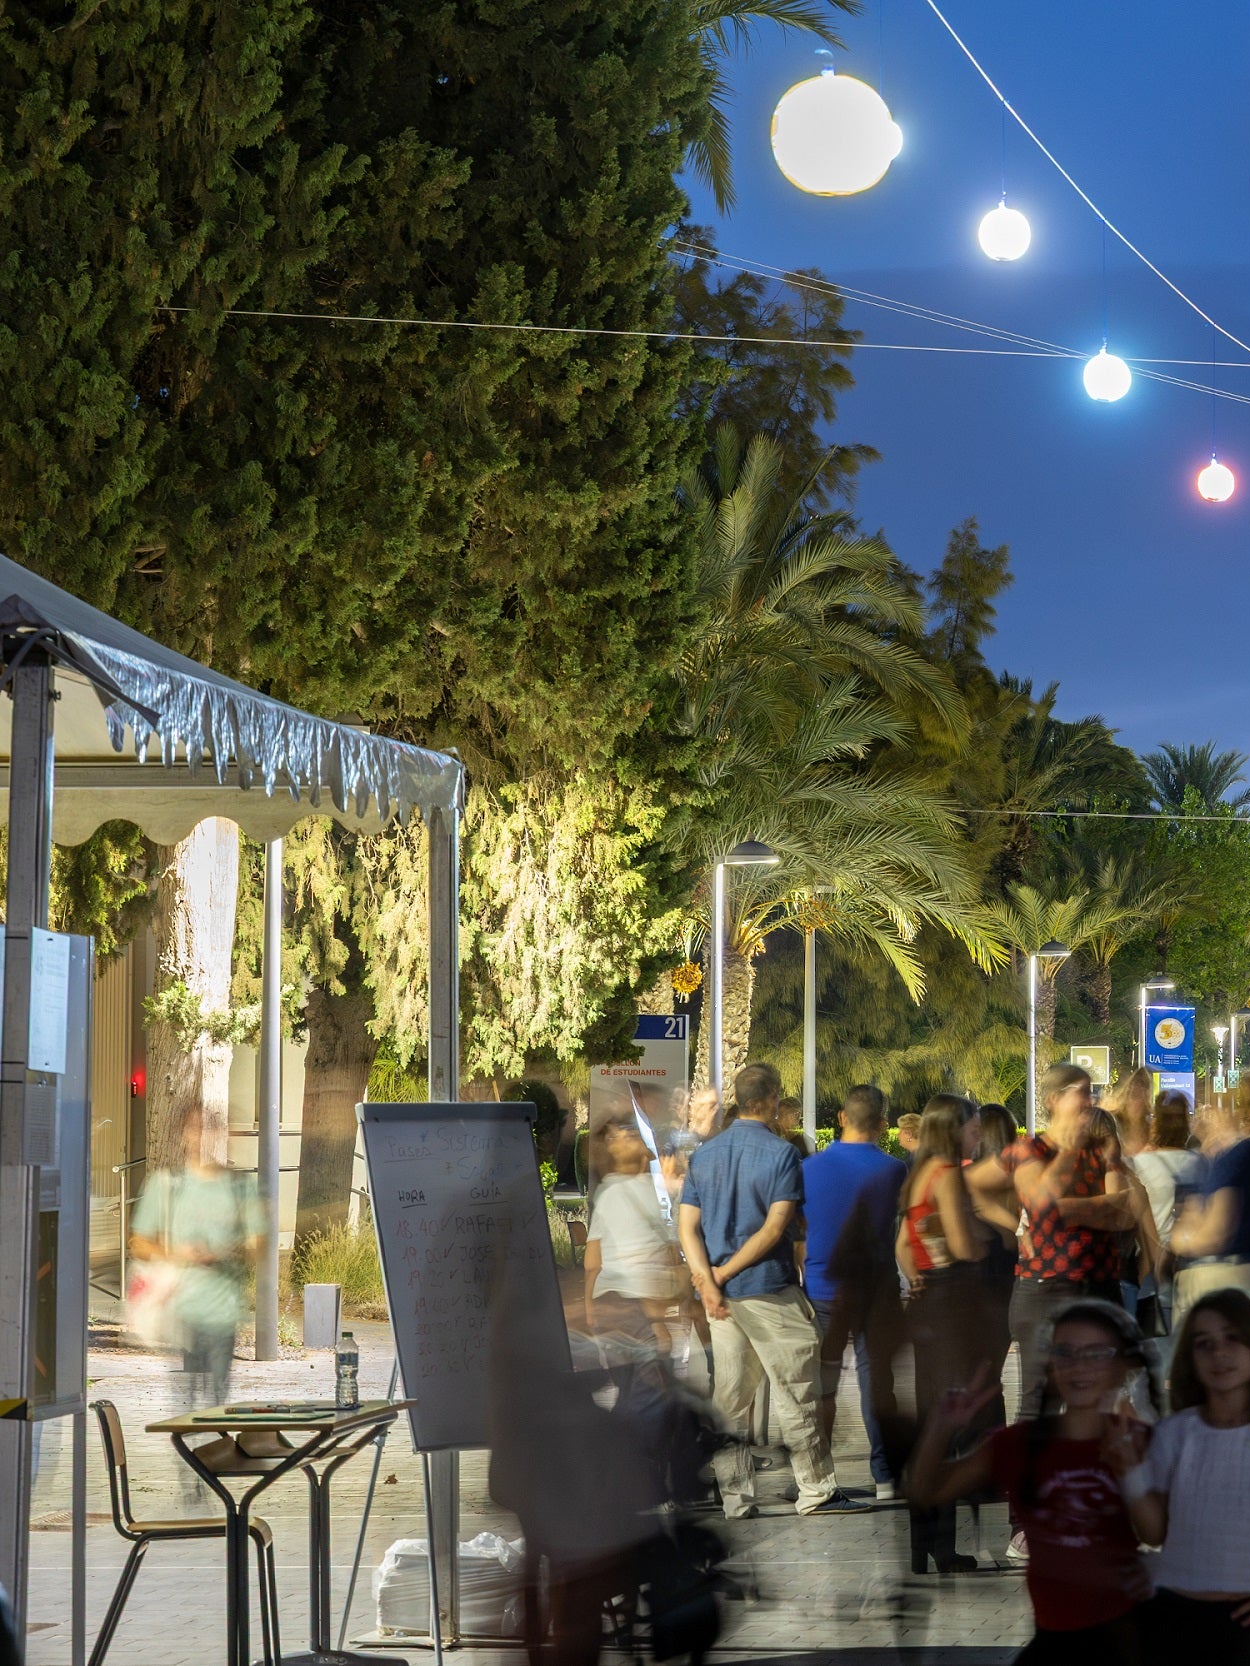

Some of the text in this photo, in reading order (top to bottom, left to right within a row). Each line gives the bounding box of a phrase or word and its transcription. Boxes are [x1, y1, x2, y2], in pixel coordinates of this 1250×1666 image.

[664, 1017, 684, 1038] 21
[1149, 1055, 1161, 1063] UA
[398, 1189, 426, 1203] HORA
